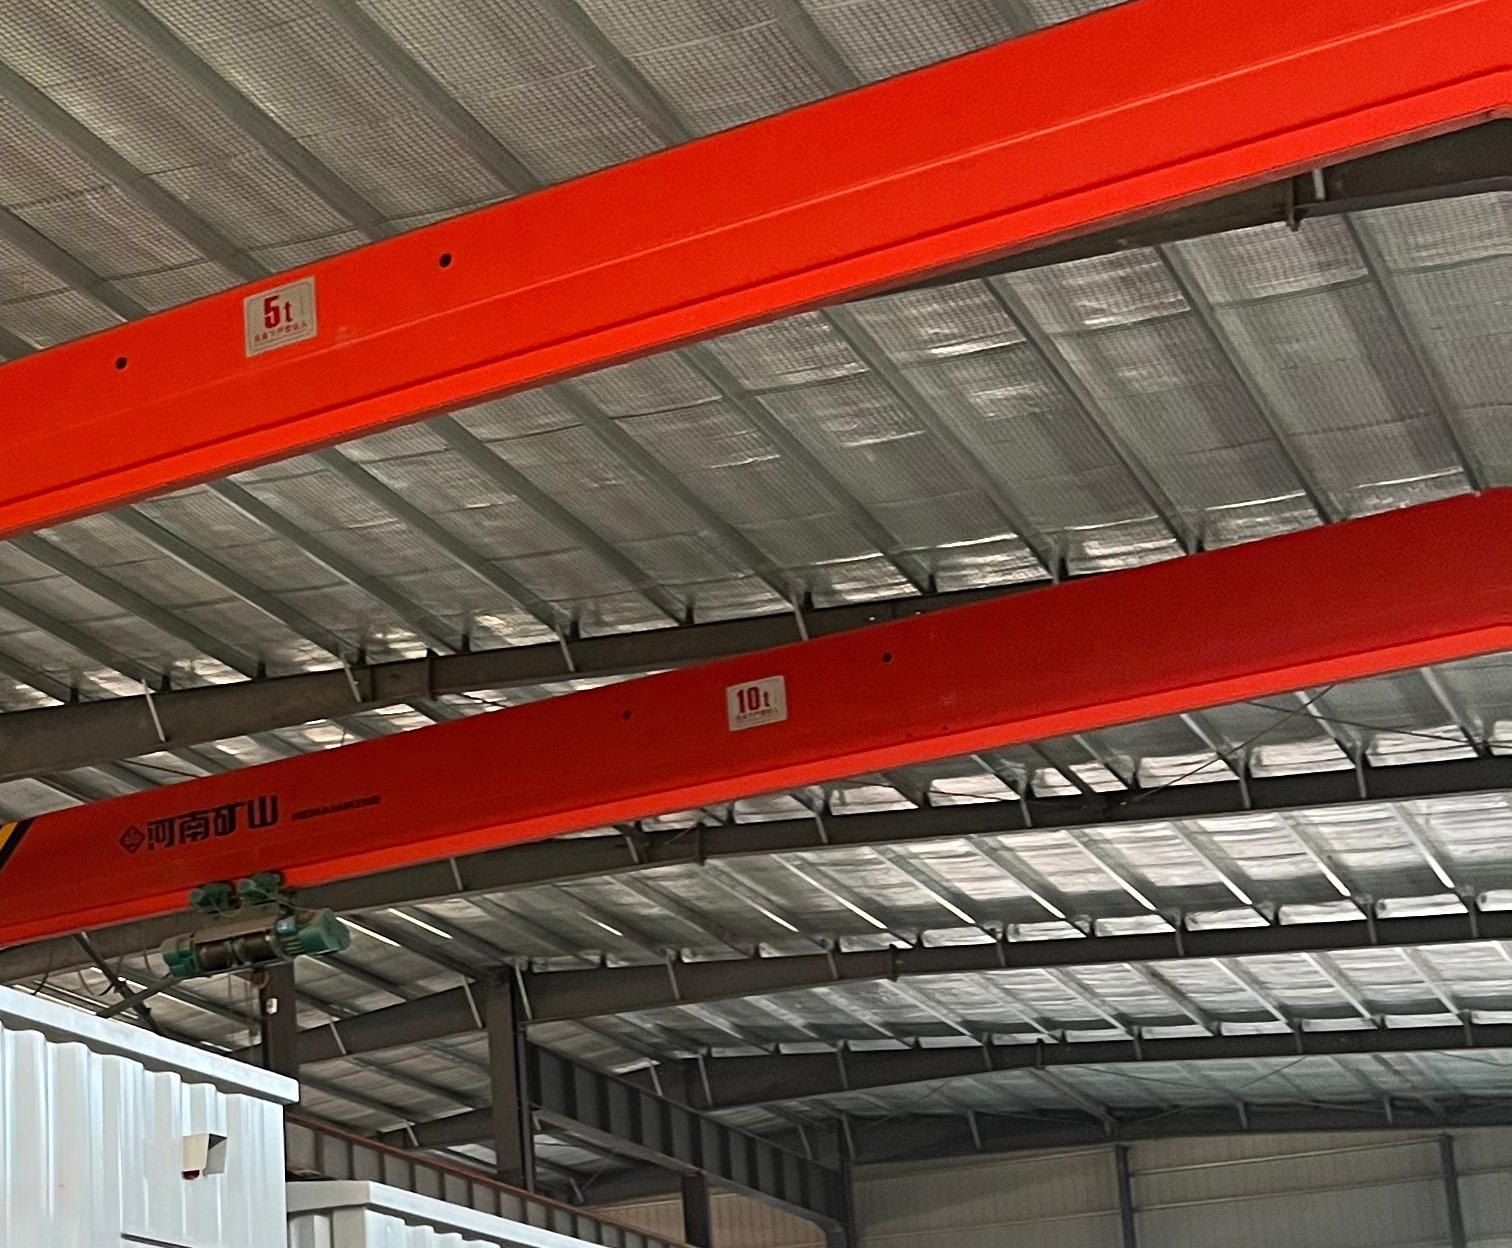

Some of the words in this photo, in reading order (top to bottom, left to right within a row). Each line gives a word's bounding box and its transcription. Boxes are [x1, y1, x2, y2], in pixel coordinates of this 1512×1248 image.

[264, 295, 294, 329] 5t
[737, 686, 771, 714] 10t
[147, 794, 278, 850] 河南矿山
